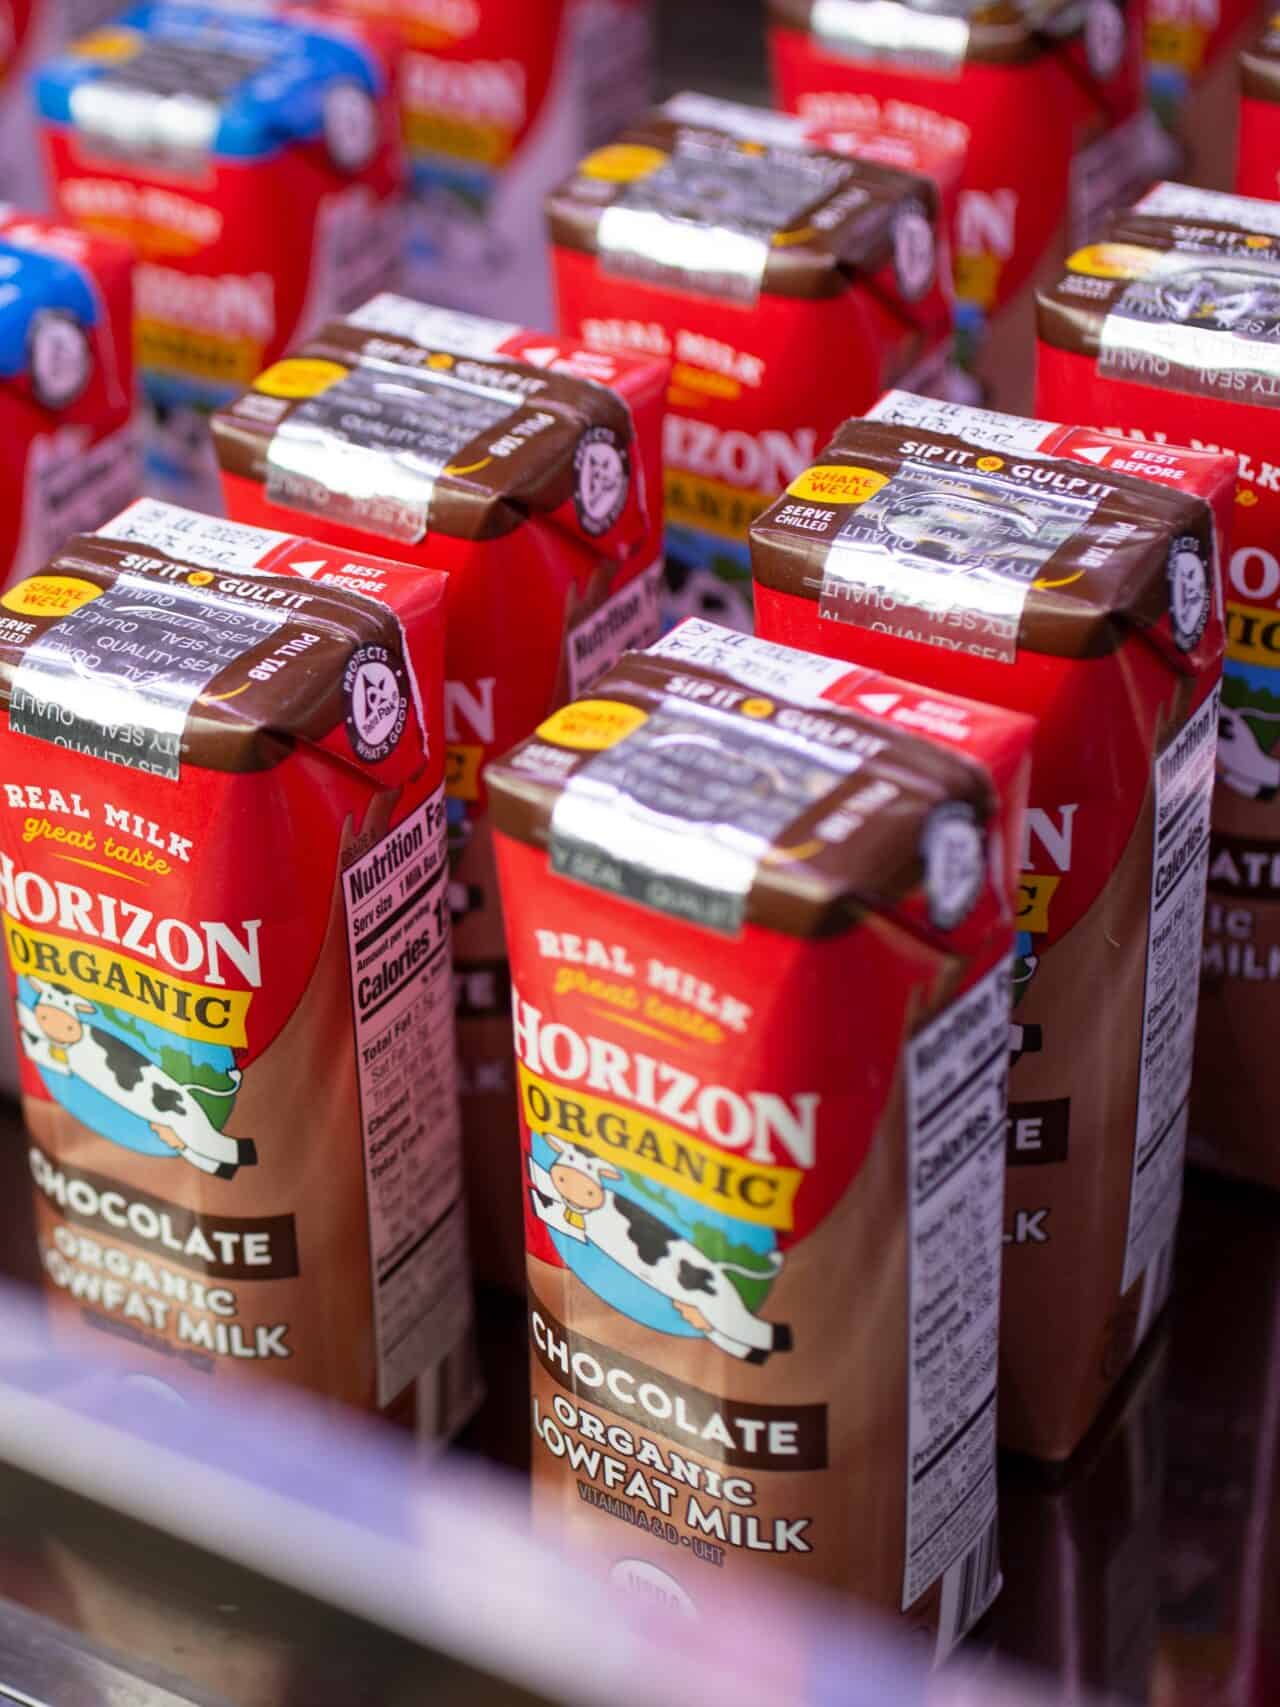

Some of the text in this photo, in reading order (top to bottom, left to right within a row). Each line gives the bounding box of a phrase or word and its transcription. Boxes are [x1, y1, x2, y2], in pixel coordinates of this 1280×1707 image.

[1100, 349, 1170, 376] QUALIT
[808, 470, 874, 489] SHAKE
[898, 439, 946, 460] SIP
[942, 449, 975, 465] IT
[1011, 462, 1091, 490] GULP
[1086, 485, 1121, 499] IT
[1111, 458, 1186, 481] BEFORE
[1130, 449, 1178, 466] BEST
[780, 503, 837, 523] SERVE
[810, 481, 864, 497] WELL
[774, 513, 831, 533] CHILLED
[840, 523, 917, 551] QUALIT
[24, 582, 90, 601] SHAKE
[106, 583, 177, 607] QUALIT
[120, 553, 167, 576] SIP
[164, 563, 190, 580] IT
[219, 578, 290, 604] GULP
[283, 593, 314, 609] IT
[319, 573, 388, 594] BEFORE
[340, 563, 387, 579] BEST
[23, 592, 72, 610] WELL
[820, 580, 897, 612] QUALIT
[71, 608, 139, 633] QUALIT
[96, 635, 179, 668] QUALITY
[247, 632, 321, 682] PULL TAB
[9, 691, 75, 726] QUALIT
[388, 697, 408, 744] GOOD
[4, 784, 193, 863] REAL MILK
[22, 816, 174, 876] great taste
[349, 826, 424, 904] Nutrition
[1155, 816, 1205, 898] Calories
[10, 929, 232, 1029] ORGANIC
[357, 928, 431, 1012] Calories
[535, 929, 753, 1033] REAL MILK
[363, 1031, 392, 1066] Total
[511, 983, 822, 1169] HORIZON
[526, 1084, 781, 1210] ORGANIC
[29, 1147, 272, 1266] CHOCOLATE
[53, 1225, 237, 1317] ORGANIC
[40, 1244, 169, 1330] OWFAT
[178, 1311, 291, 1359] MILK
[532, 1310, 800, 1455] CHOCOLATE
[553, 1393, 757, 1507] ORGANIC
[532, 1396, 814, 1553] LOWFAT MILK
[577, 1479, 638, 1527] VITAMIN
[692, 1535, 725, 1567] UHT
